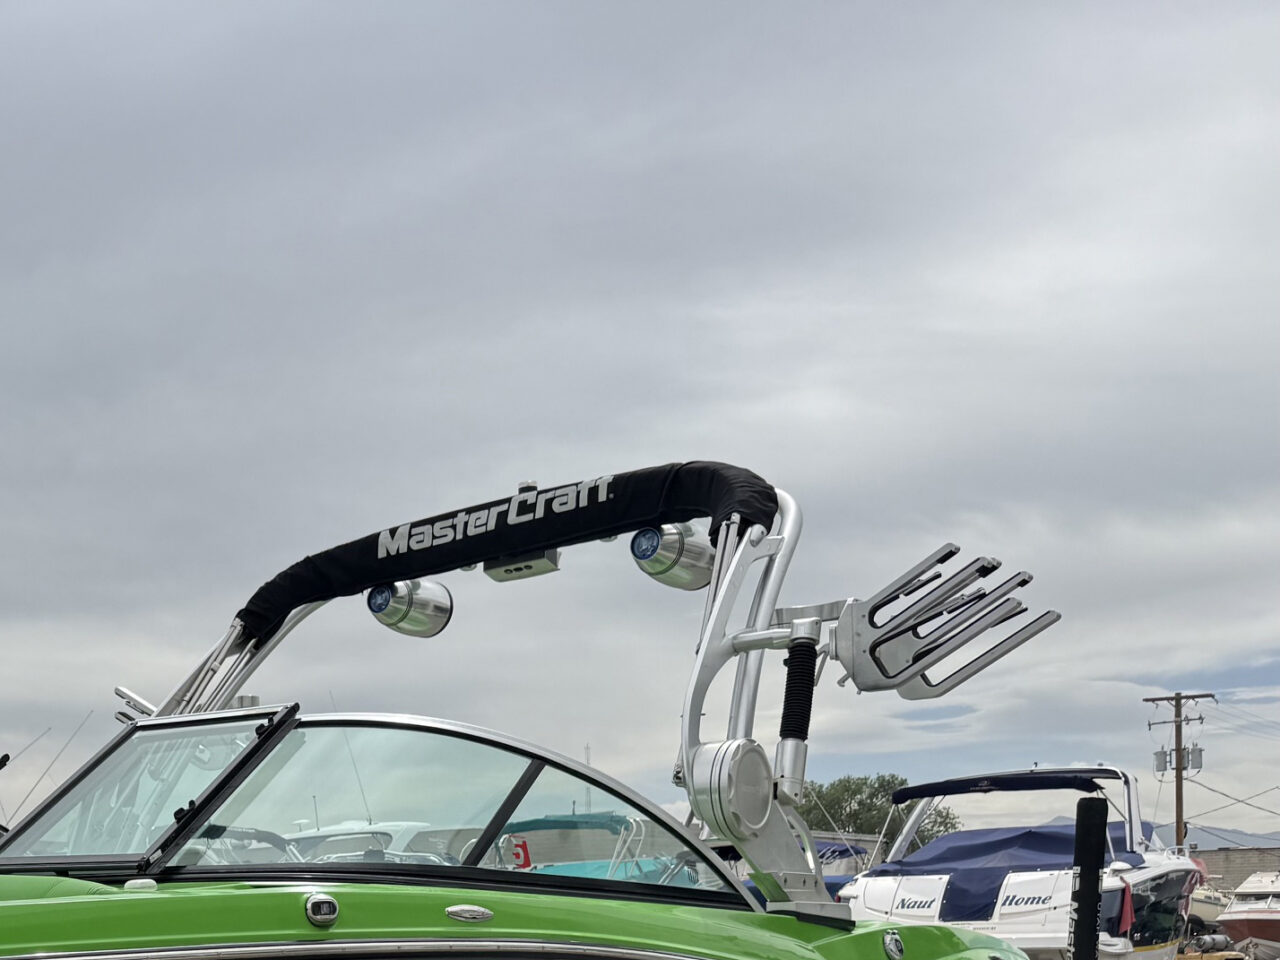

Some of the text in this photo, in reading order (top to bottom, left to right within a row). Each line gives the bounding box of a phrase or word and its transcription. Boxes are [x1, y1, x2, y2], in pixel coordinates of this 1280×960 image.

[377, 475, 615, 560] MasterCraft
[895, 895, 1053, 910] Naut Home
